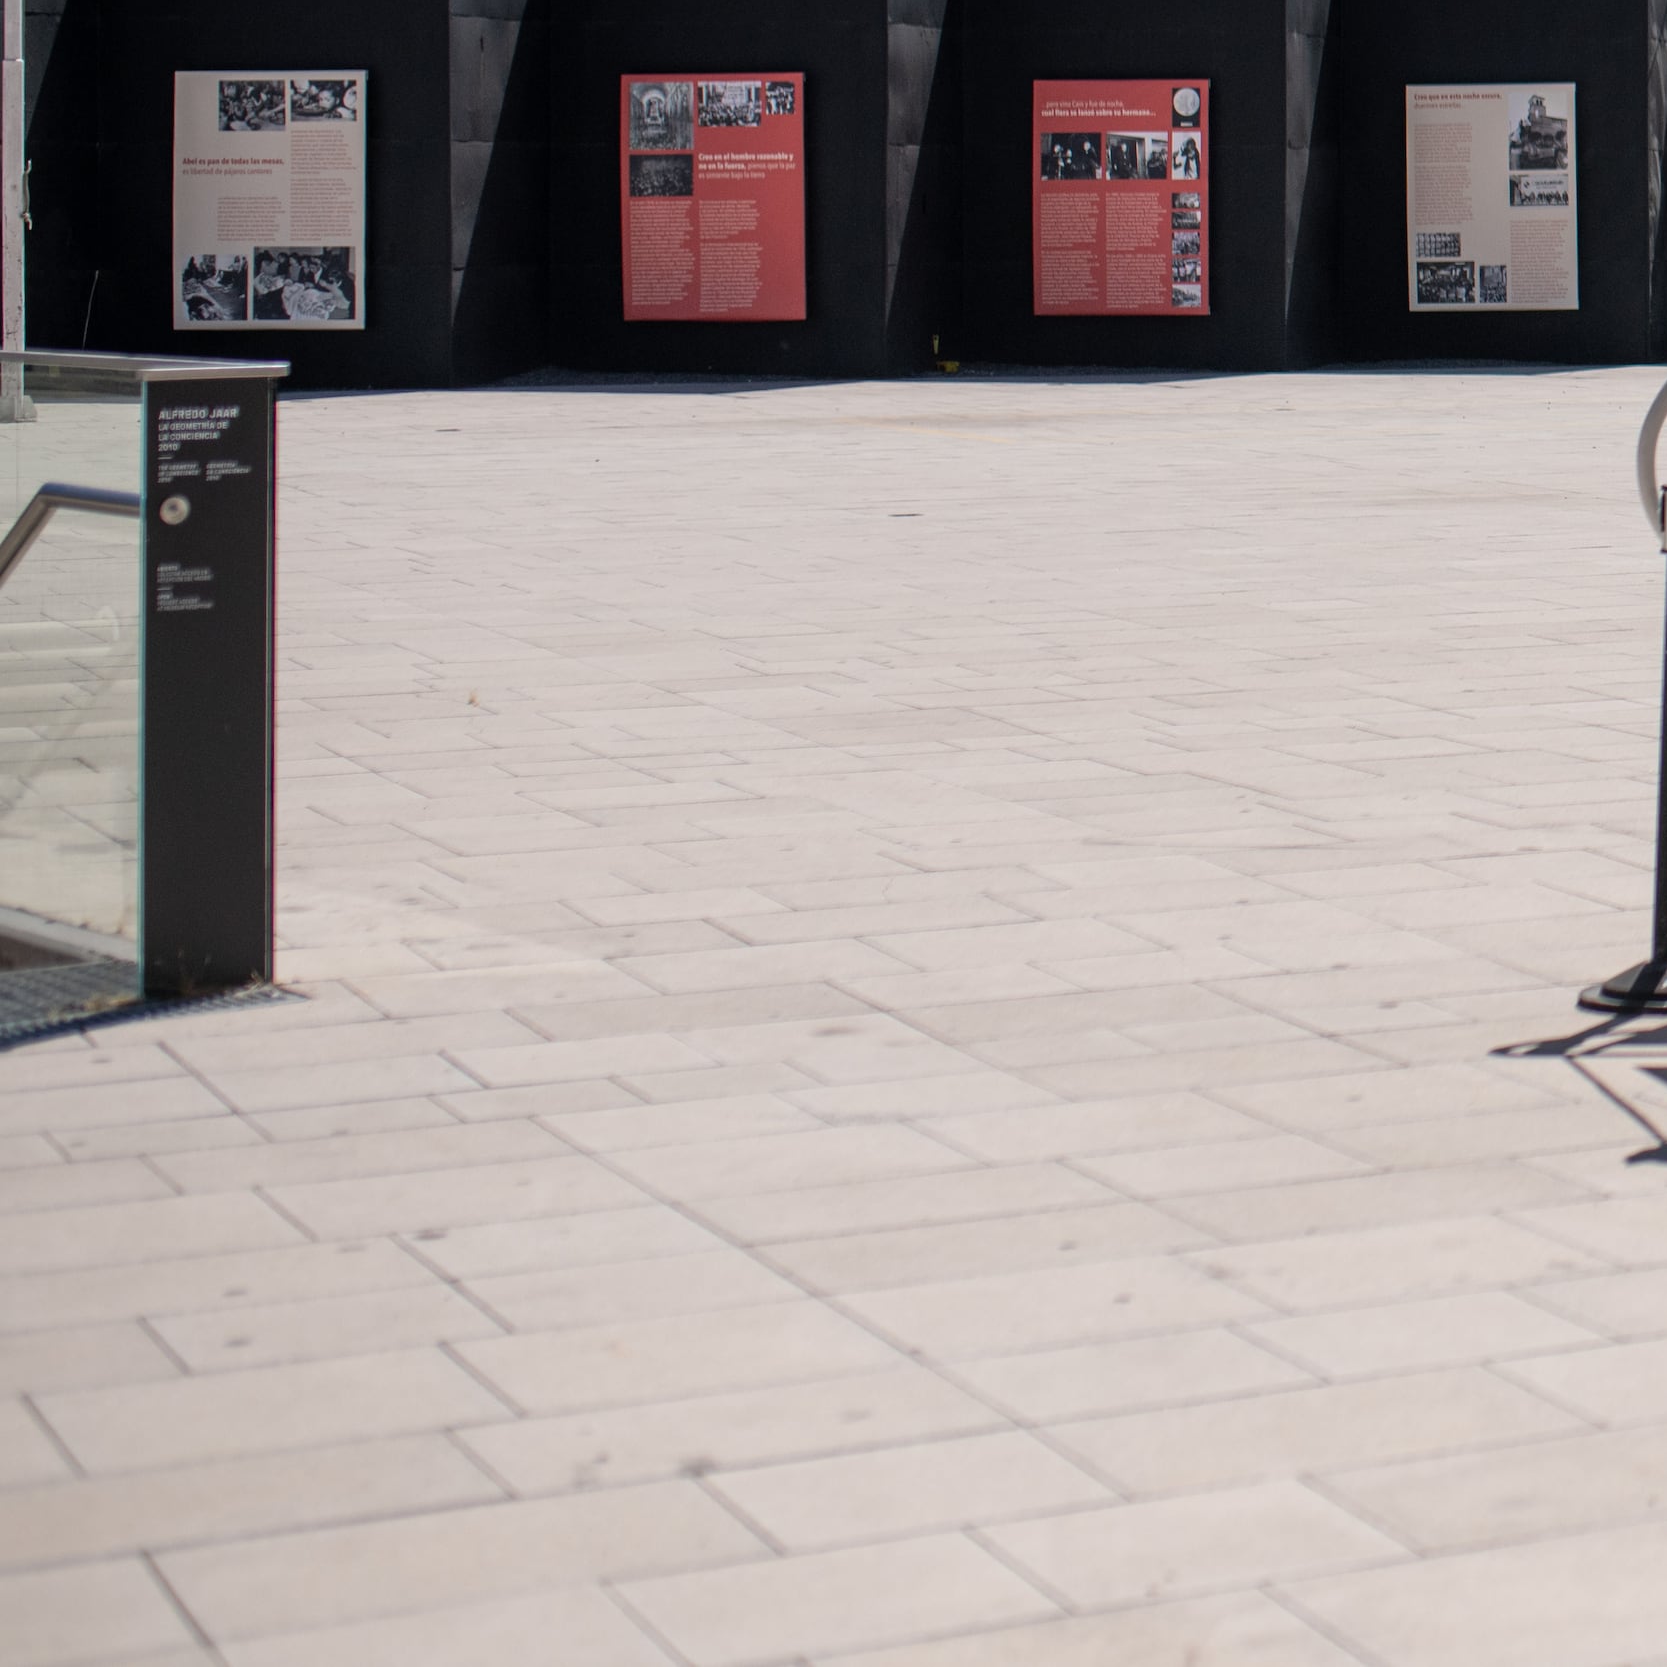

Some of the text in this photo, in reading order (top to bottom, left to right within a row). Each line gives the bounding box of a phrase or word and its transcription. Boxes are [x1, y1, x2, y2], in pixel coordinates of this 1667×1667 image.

[730, 152, 756, 160] hombre
[756, 152, 788, 160] razonable
[182, 157, 198, 165] Abel
[221, 157, 230, 165] de
[231, 157, 249, 165] todas
[250, 157, 260, 165] las
[717, 162, 724, 170] la
[158, 407, 239, 420] ALFREDO JAAR
[158, 423, 169, 431] LA
[216, 421, 229, 430] DE
[158, 432, 219, 442] LA CONCIENCIA
[158, 443, 179, 452] 2010
